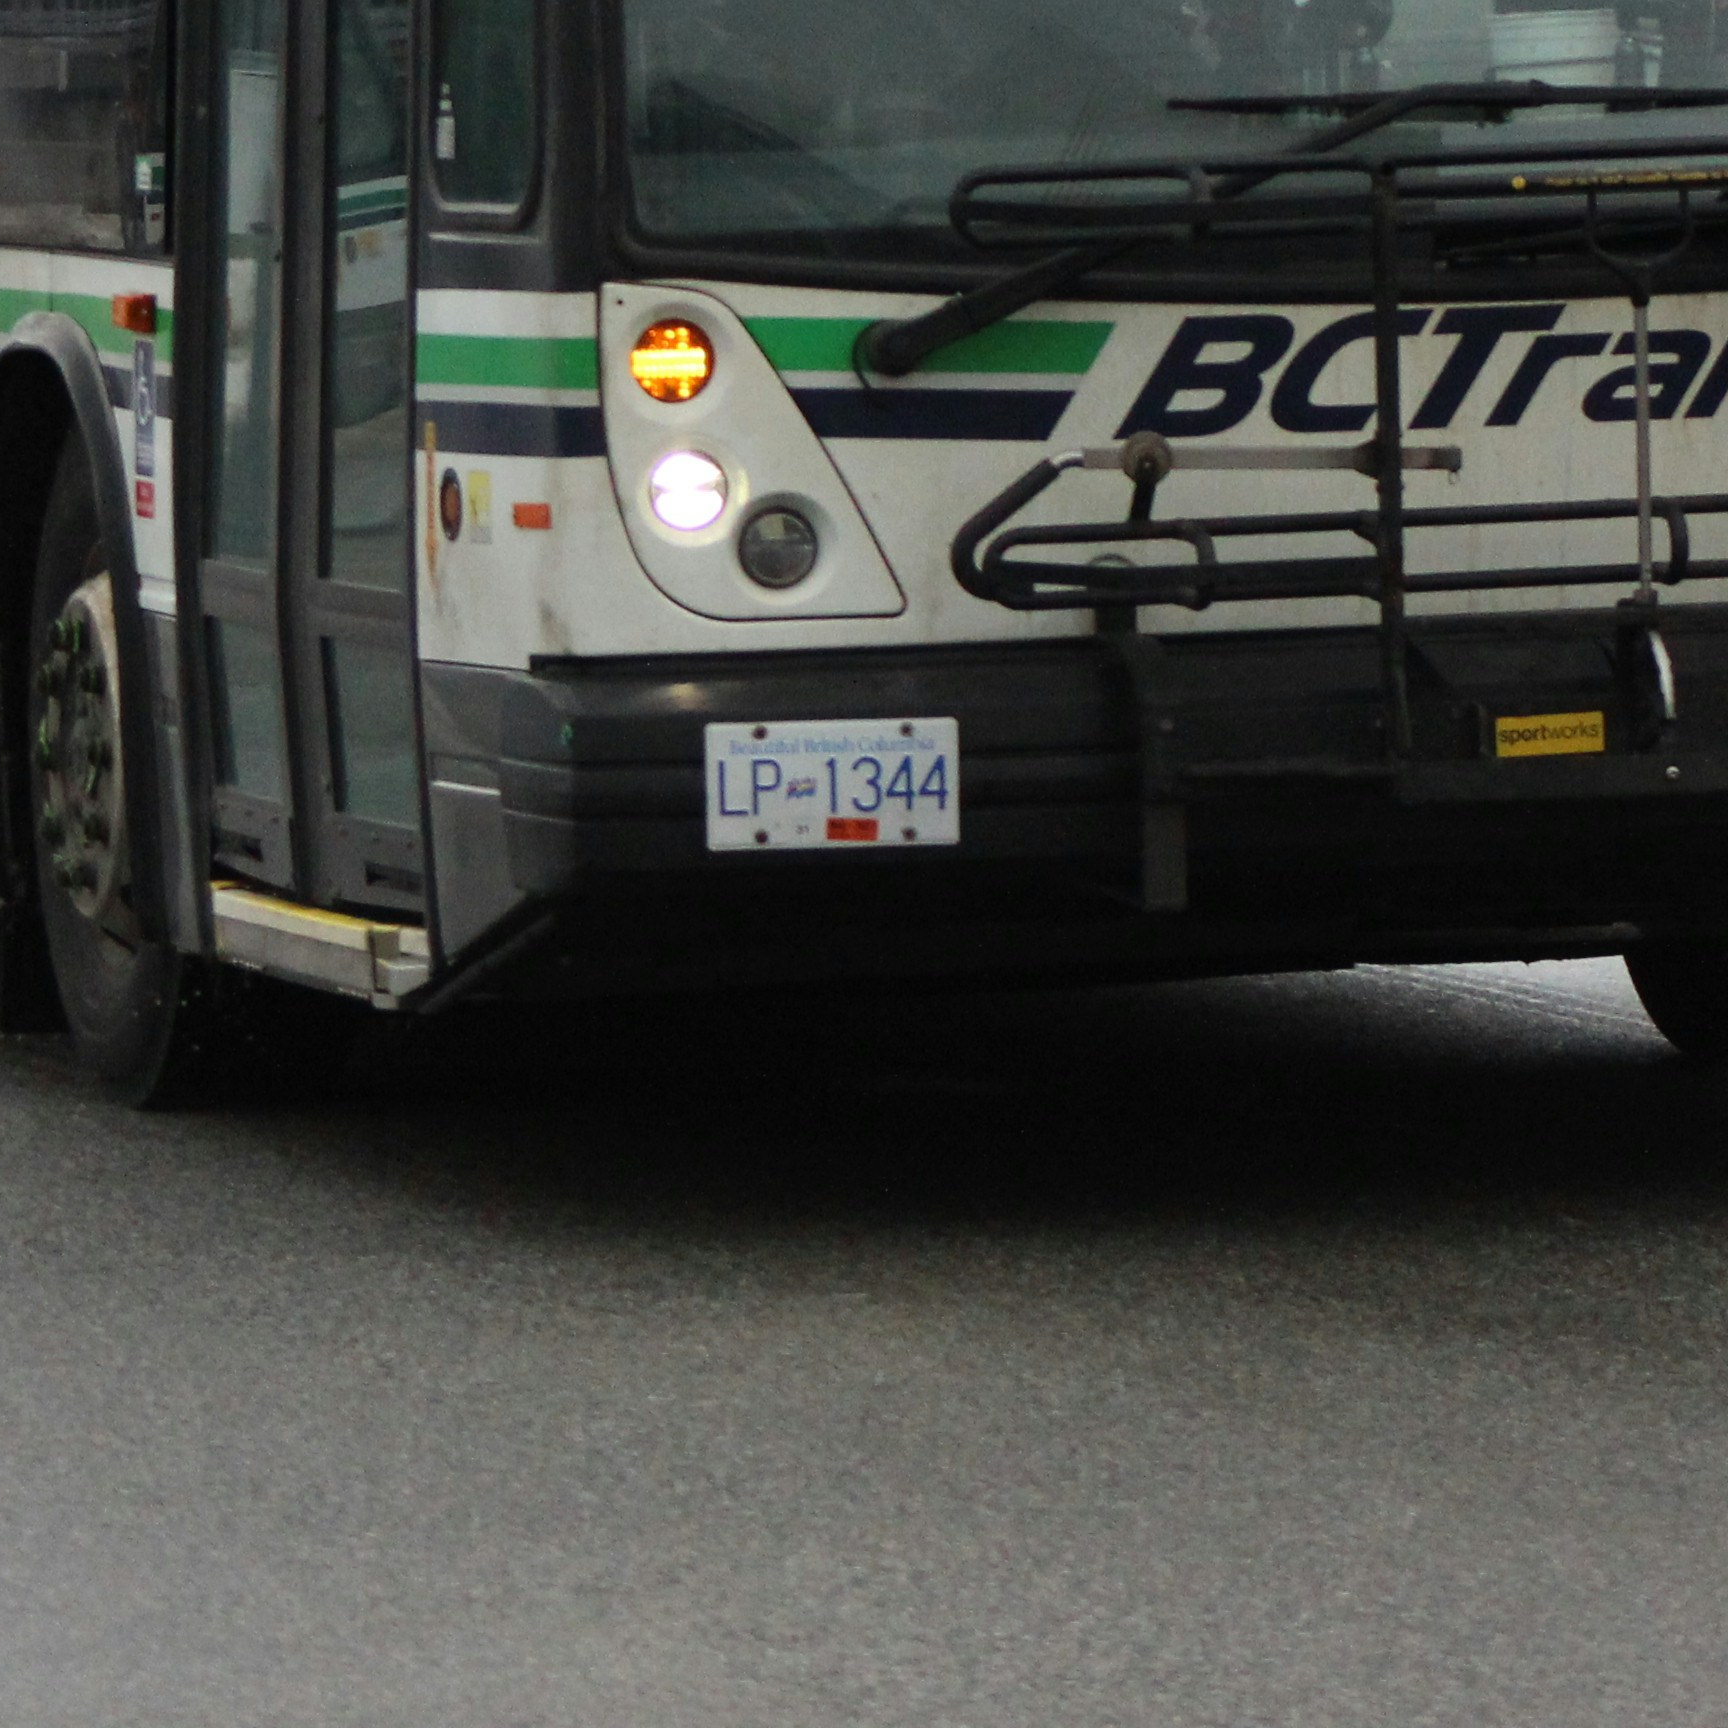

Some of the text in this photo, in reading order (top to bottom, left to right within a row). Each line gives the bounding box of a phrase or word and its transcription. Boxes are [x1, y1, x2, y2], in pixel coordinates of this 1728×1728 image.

[1499, 721, 1599, 746] sportworks
[718, 753, 949, 816] LP 1344
